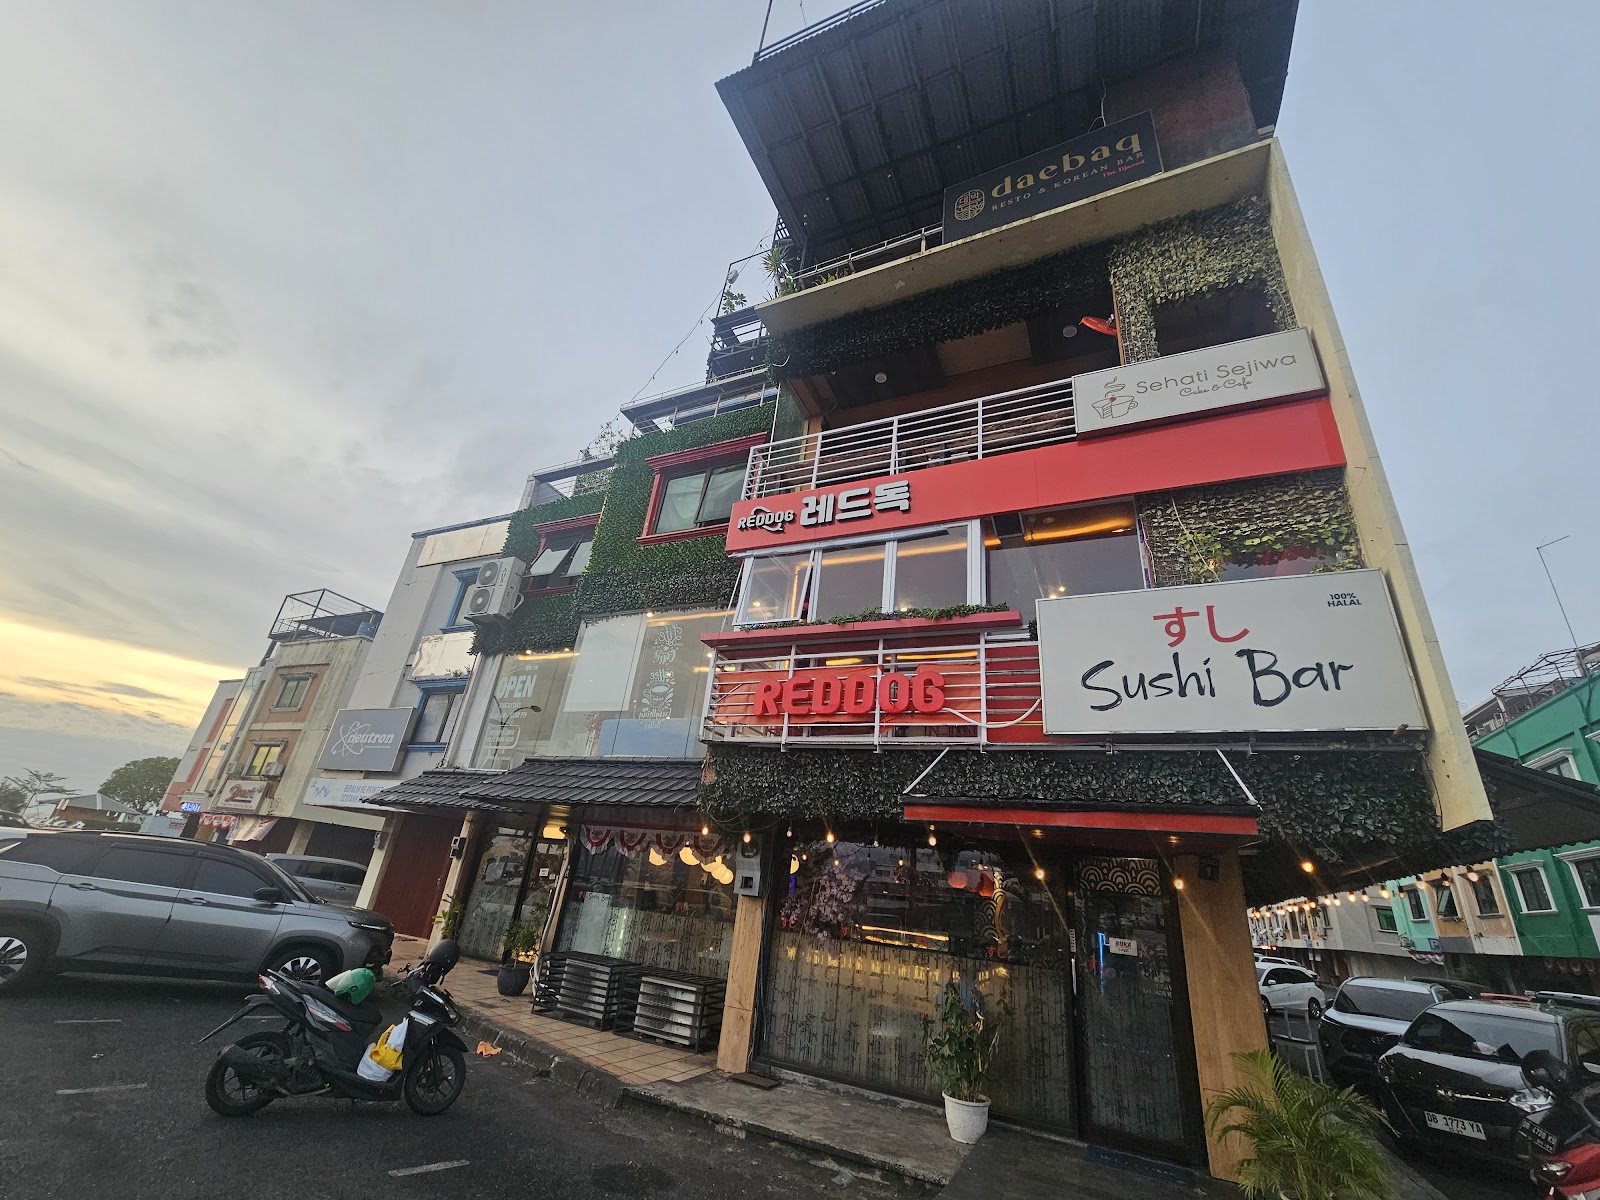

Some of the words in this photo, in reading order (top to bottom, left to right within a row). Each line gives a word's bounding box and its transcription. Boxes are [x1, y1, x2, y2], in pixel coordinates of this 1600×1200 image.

[991, 133, 1142, 198] daebaq
[991, 192, 1031, 211] RESTO
[1038, 186, 1046, 194] &
[1053, 164, 1109, 189] KOREAN
[1116, 150, 1145, 166] BAR
[1136, 369, 1209, 394] Sehati
[1216, 353, 1297, 379] Sejiwa
[1179, 384, 1210, 397] Cake
[1211, 382, 1222, 391] &
[737, 509, 795, 529] REDDOG
[800, 480, 910, 527] 레드독
[1327, 598, 1362, 607] HALAL
[1329, 592, 1357, 600] 100%
[1152, 605, 1250, 647] すし
[495, 675, 537, 698] OPEN
[753, 671, 946, 716] REDDOG
[1081, 651, 1216, 711] Sushi
[1234, 648, 1354, 707] Bar
[346, 731, 395, 744] neutron
[1426, 1113, 1439, 1124] DB
[1443, 1116, 1467, 1131] 1773
[1468, 1122, 1483, 1135] YA
